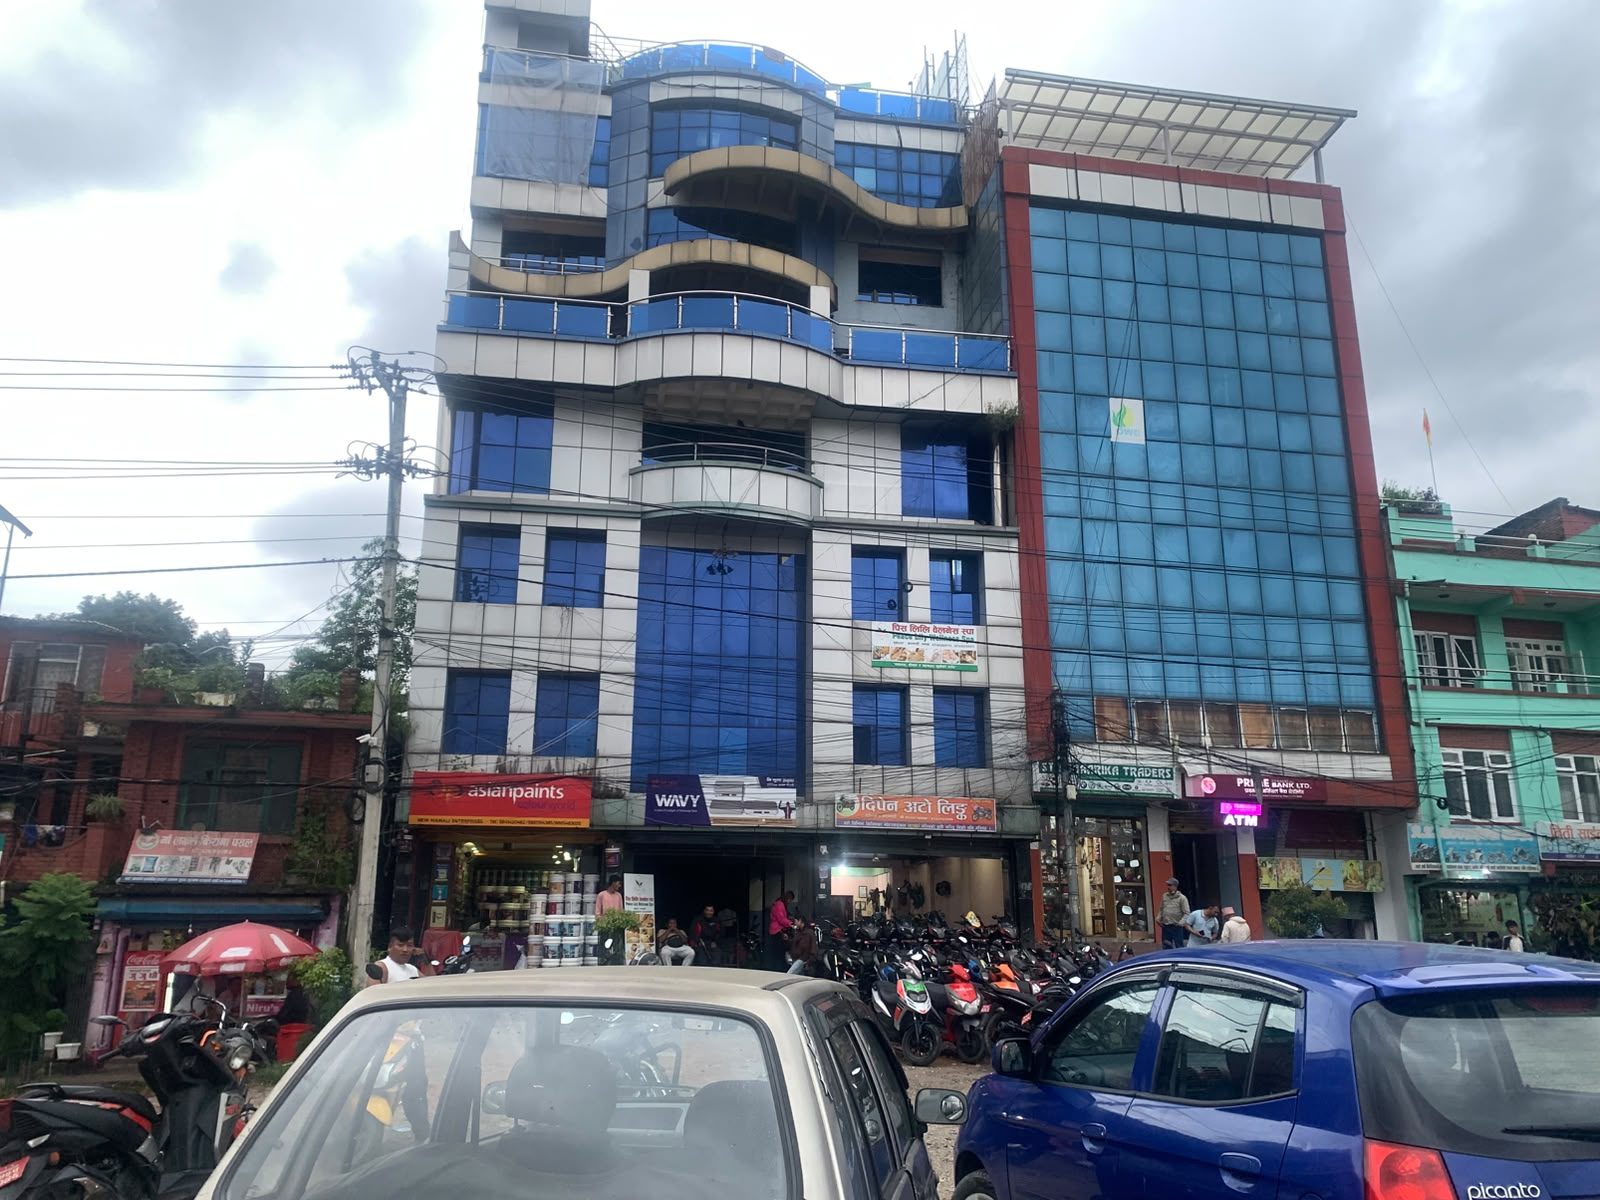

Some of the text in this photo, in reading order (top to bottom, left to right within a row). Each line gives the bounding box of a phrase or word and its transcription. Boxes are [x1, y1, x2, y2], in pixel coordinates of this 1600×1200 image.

[1124, 766, 1172, 779] TRADERS
[1236, 778, 1270, 788] PRIE
[1295, 782, 1313, 790] LTD.
[467, 782, 565, 804] asianpaints
[655, 794, 700, 808] WAVY
[861, 796, 898, 812] दिपेन
[903, 798, 932, 814] अटो
[1223, 814, 1258, 827] ATM
[1467, 1182, 1541, 1200] picanto
